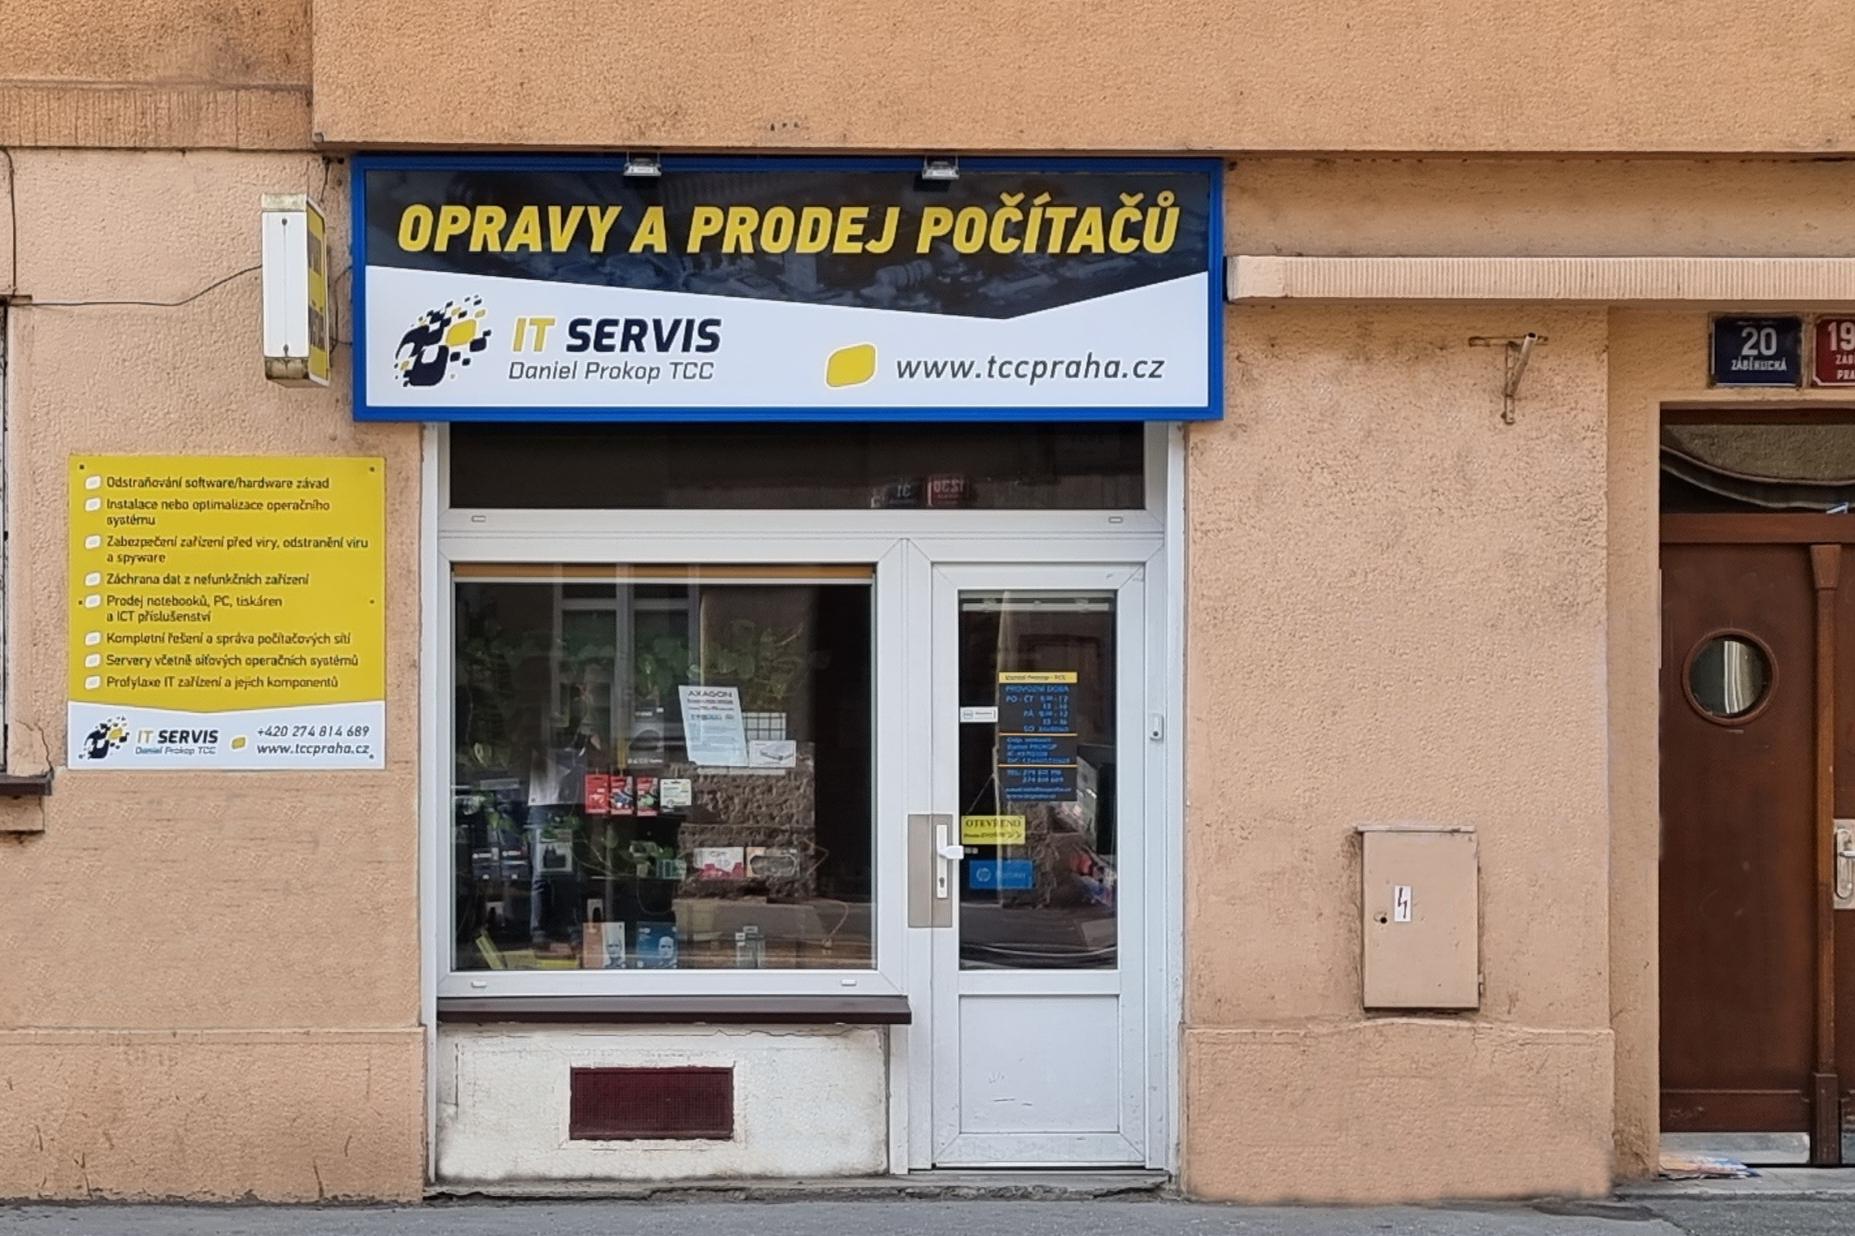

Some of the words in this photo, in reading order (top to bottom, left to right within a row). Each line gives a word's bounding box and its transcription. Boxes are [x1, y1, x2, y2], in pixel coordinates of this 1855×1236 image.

[398, 204, 623, 255] OPRAVY
[632, 204, 669, 255] A
[686, 204, 898, 255] PRODEJ
[915, 191, 1180, 255] POČÍTAČŮ
[512, 318, 556, 353] IT
[566, 318, 722, 353] SERVIS
[1741, 327, 1777, 355] 20
[509, 361, 578, 382] Daniel
[585, 361, 662, 385] Prokop
[671, 361, 714, 382] TCC
[896, 352, 1165, 386] www.tccpraha.cz
[107, 476, 182, 489] Odstraňování
[185, 477, 293, 489] software/hardware
[296, 477, 329, 489] závad
[107, 499, 158, 511] Instalace
[162, 499, 189, 511] nebo
[193, 499, 263, 513] optimalizace
[267, 499, 330, 513] operačního
[107, 515, 155, 527] systému
[107, 536, 177, 549] Zabezpečení
[181, 536, 224, 547] zařízení
[227, 536, 252, 549] před
[283, 536, 343, 548] odstranění
[107, 553, 114, 563] a
[117, 553, 165, 565] spyware
[107, 573, 160, 585] Záchrana
[163, 573, 180, 585] dat
[184, 576, 190, 585] z
[194, 573, 262, 585] nefunkčních
[265, 573, 309, 585] zařízení
[107, 596, 143, 608] Prodej
[147, 595, 210, 607] notebooků,
[214, 596, 232, 608] PC,
[236, 596, 282, 606] tiskáren
[107, 612, 114, 622] a
[117, 611, 134, 622] ICT
[138, 611, 211, 623] příslušenství
[107, 633, 164, 646] Kompletní
[168, 633, 204, 644] řešení
[207, 635, 213, 644] a
[217, 634, 254, 646] správa
[258, 633, 330, 646] počítačových
[334, 633, 351, 644] sítí
[107, 655, 151, 668] Servery
[155, 655, 192, 666] včetně
[195, 655, 242, 668] síťových
[245, 656, 307, 668] operačních
[311, 655, 358, 668] systémů
[107, 677, 161, 689] Profylaxe
[164, 677, 174, 688] IT
[178, 677, 221, 688] zařízení
[225, 679, 231, 688] a
[235, 677, 263, 690] jejich
[267, 677, 338, 690] komponentů
[138, 731, 154, 743] IT
[158, 731, 218, 744] SERVIS
[258, 726, 288, 737] +420
[293, 726, 316, 737] 274
[319, 726, 343, 737] 814
[347, 726, 369, 737] 689
[257, 743, 369, 755] www.tccpraha.cz
